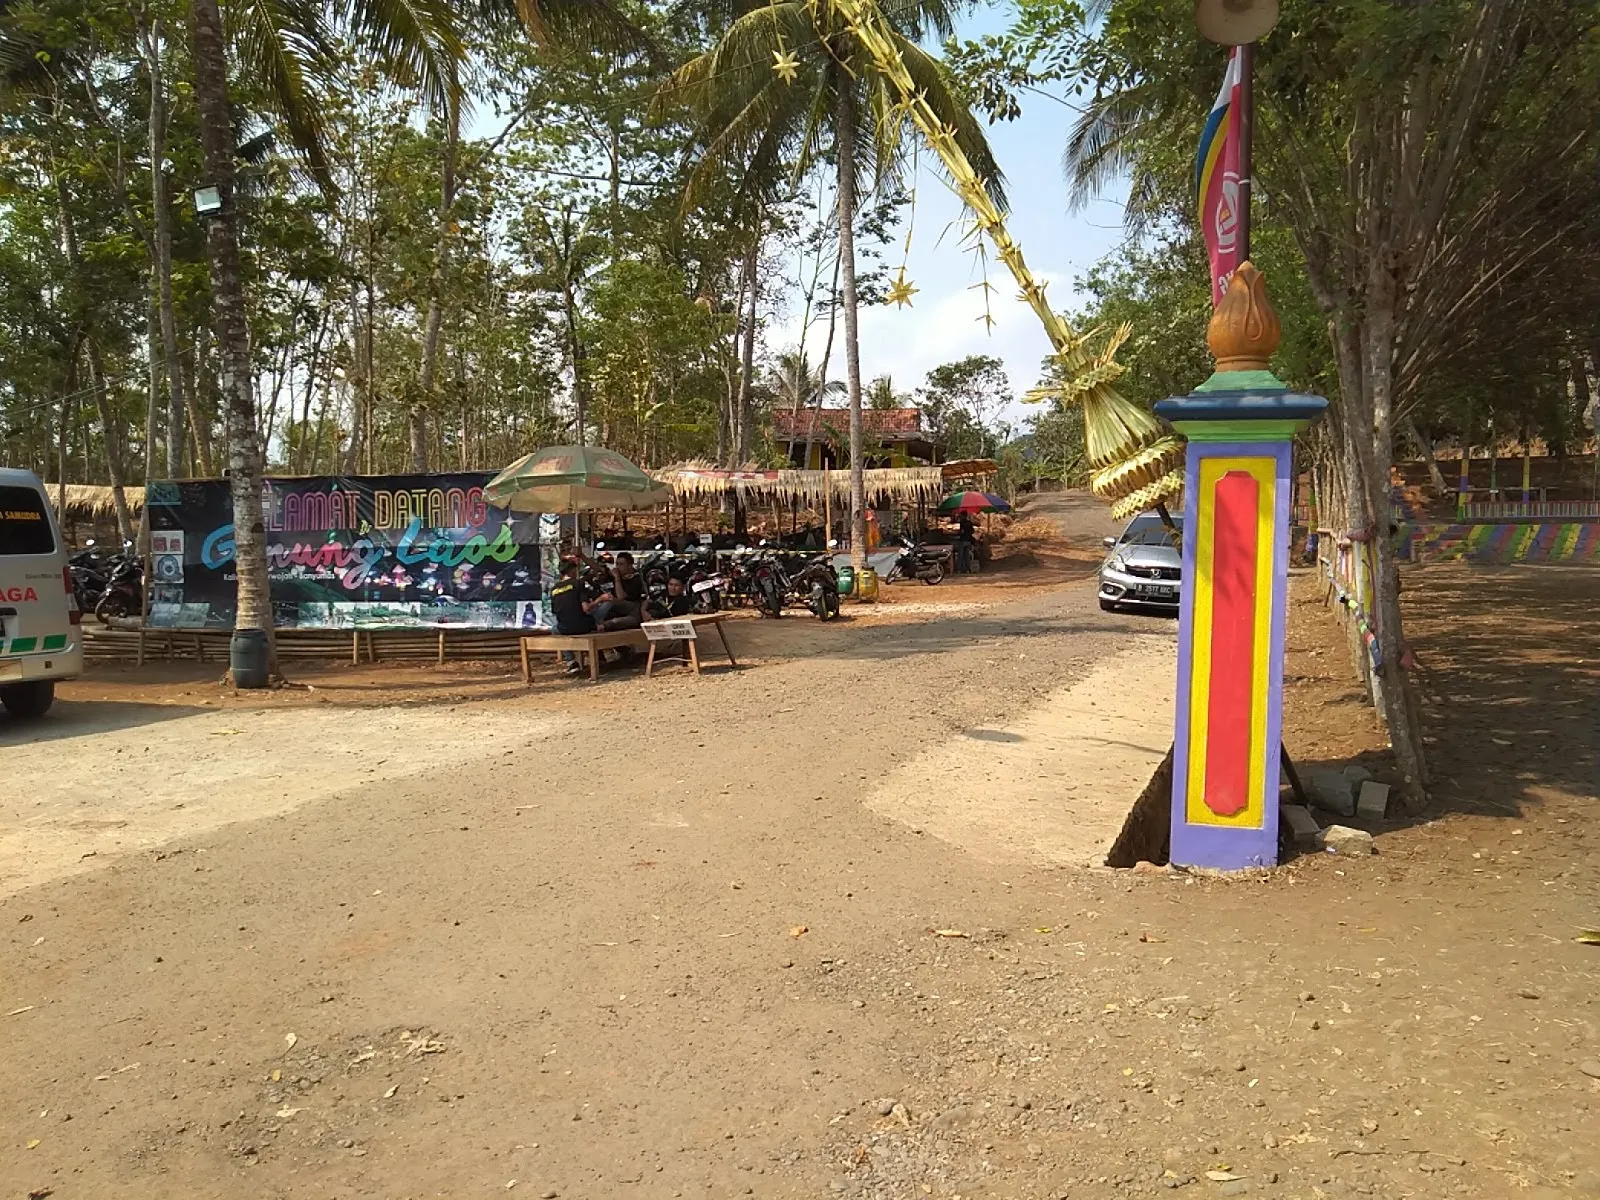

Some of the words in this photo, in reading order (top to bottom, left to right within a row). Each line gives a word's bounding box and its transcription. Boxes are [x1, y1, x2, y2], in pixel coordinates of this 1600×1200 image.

[262, 489, 361, 532] LAMAT
[374, 486, 488, 529] DATANG
[201, 523, 384, 590] Gnung
[396, 515, 520, 567] Laos
